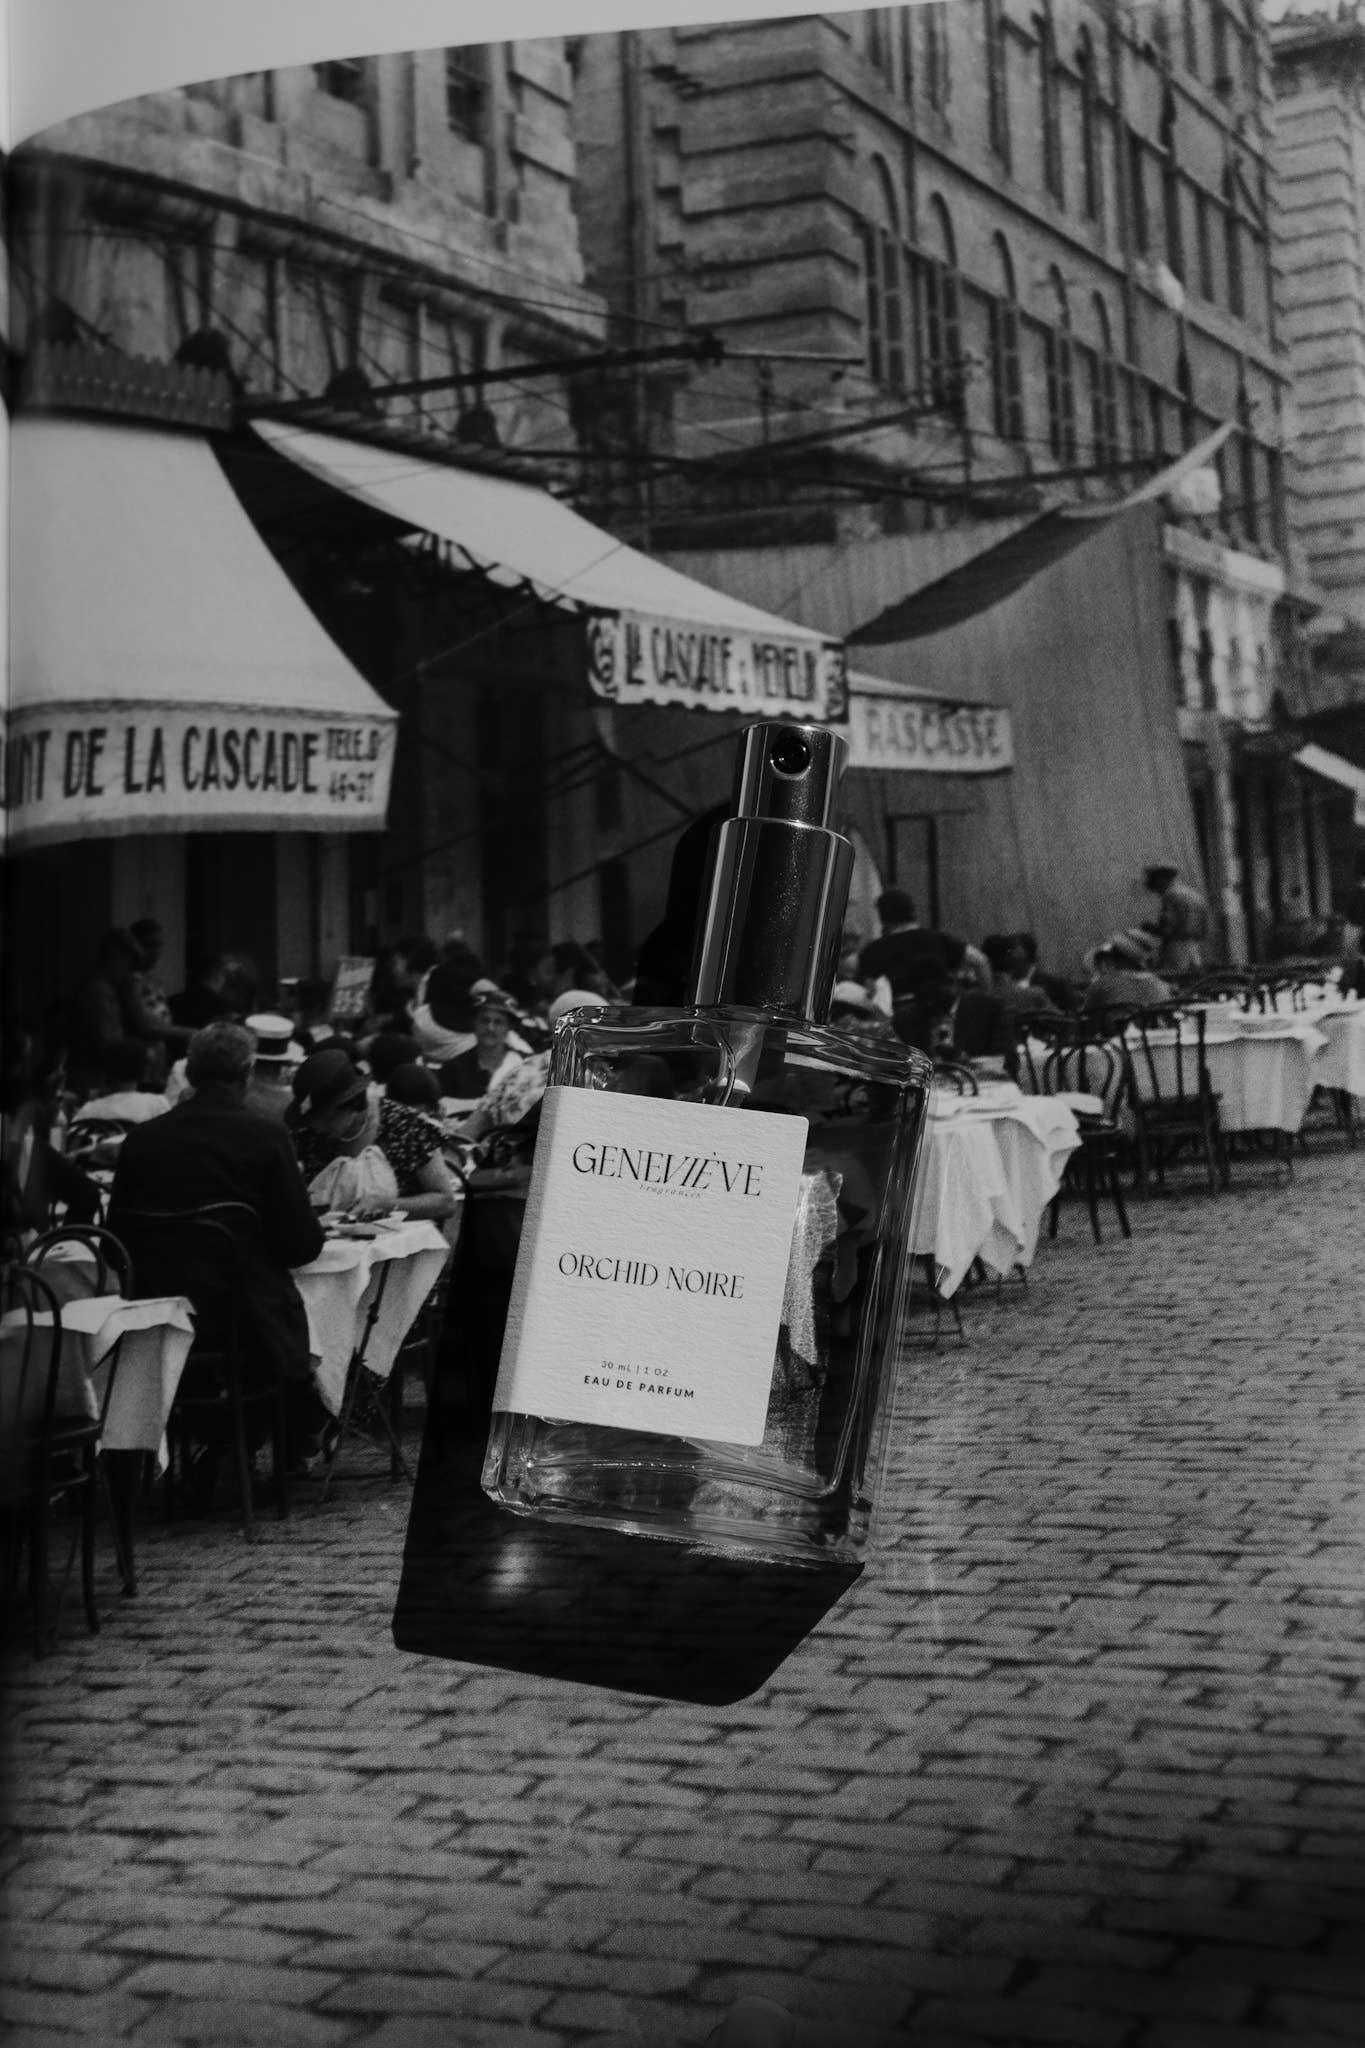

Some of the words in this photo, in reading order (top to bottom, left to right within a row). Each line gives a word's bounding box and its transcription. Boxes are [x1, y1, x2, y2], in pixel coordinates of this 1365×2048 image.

[63, 727, 107, 799] DE
[124, 726, 166, 794] LA
[182, 725, 319, 793] CASCADE
[573, 1142, 764, 1197] GENEVIÈVE
[558, 1252, 659, 1287] ORCHID
[665, 1265, 745, 1299] NOIRE
[584, 1375, 610, 1387] EAU
[616, 1379, 633, 1390] DE
[639, 1382, 695, 1398] PARFUM
[601, 1360, 614, 1369] 30
